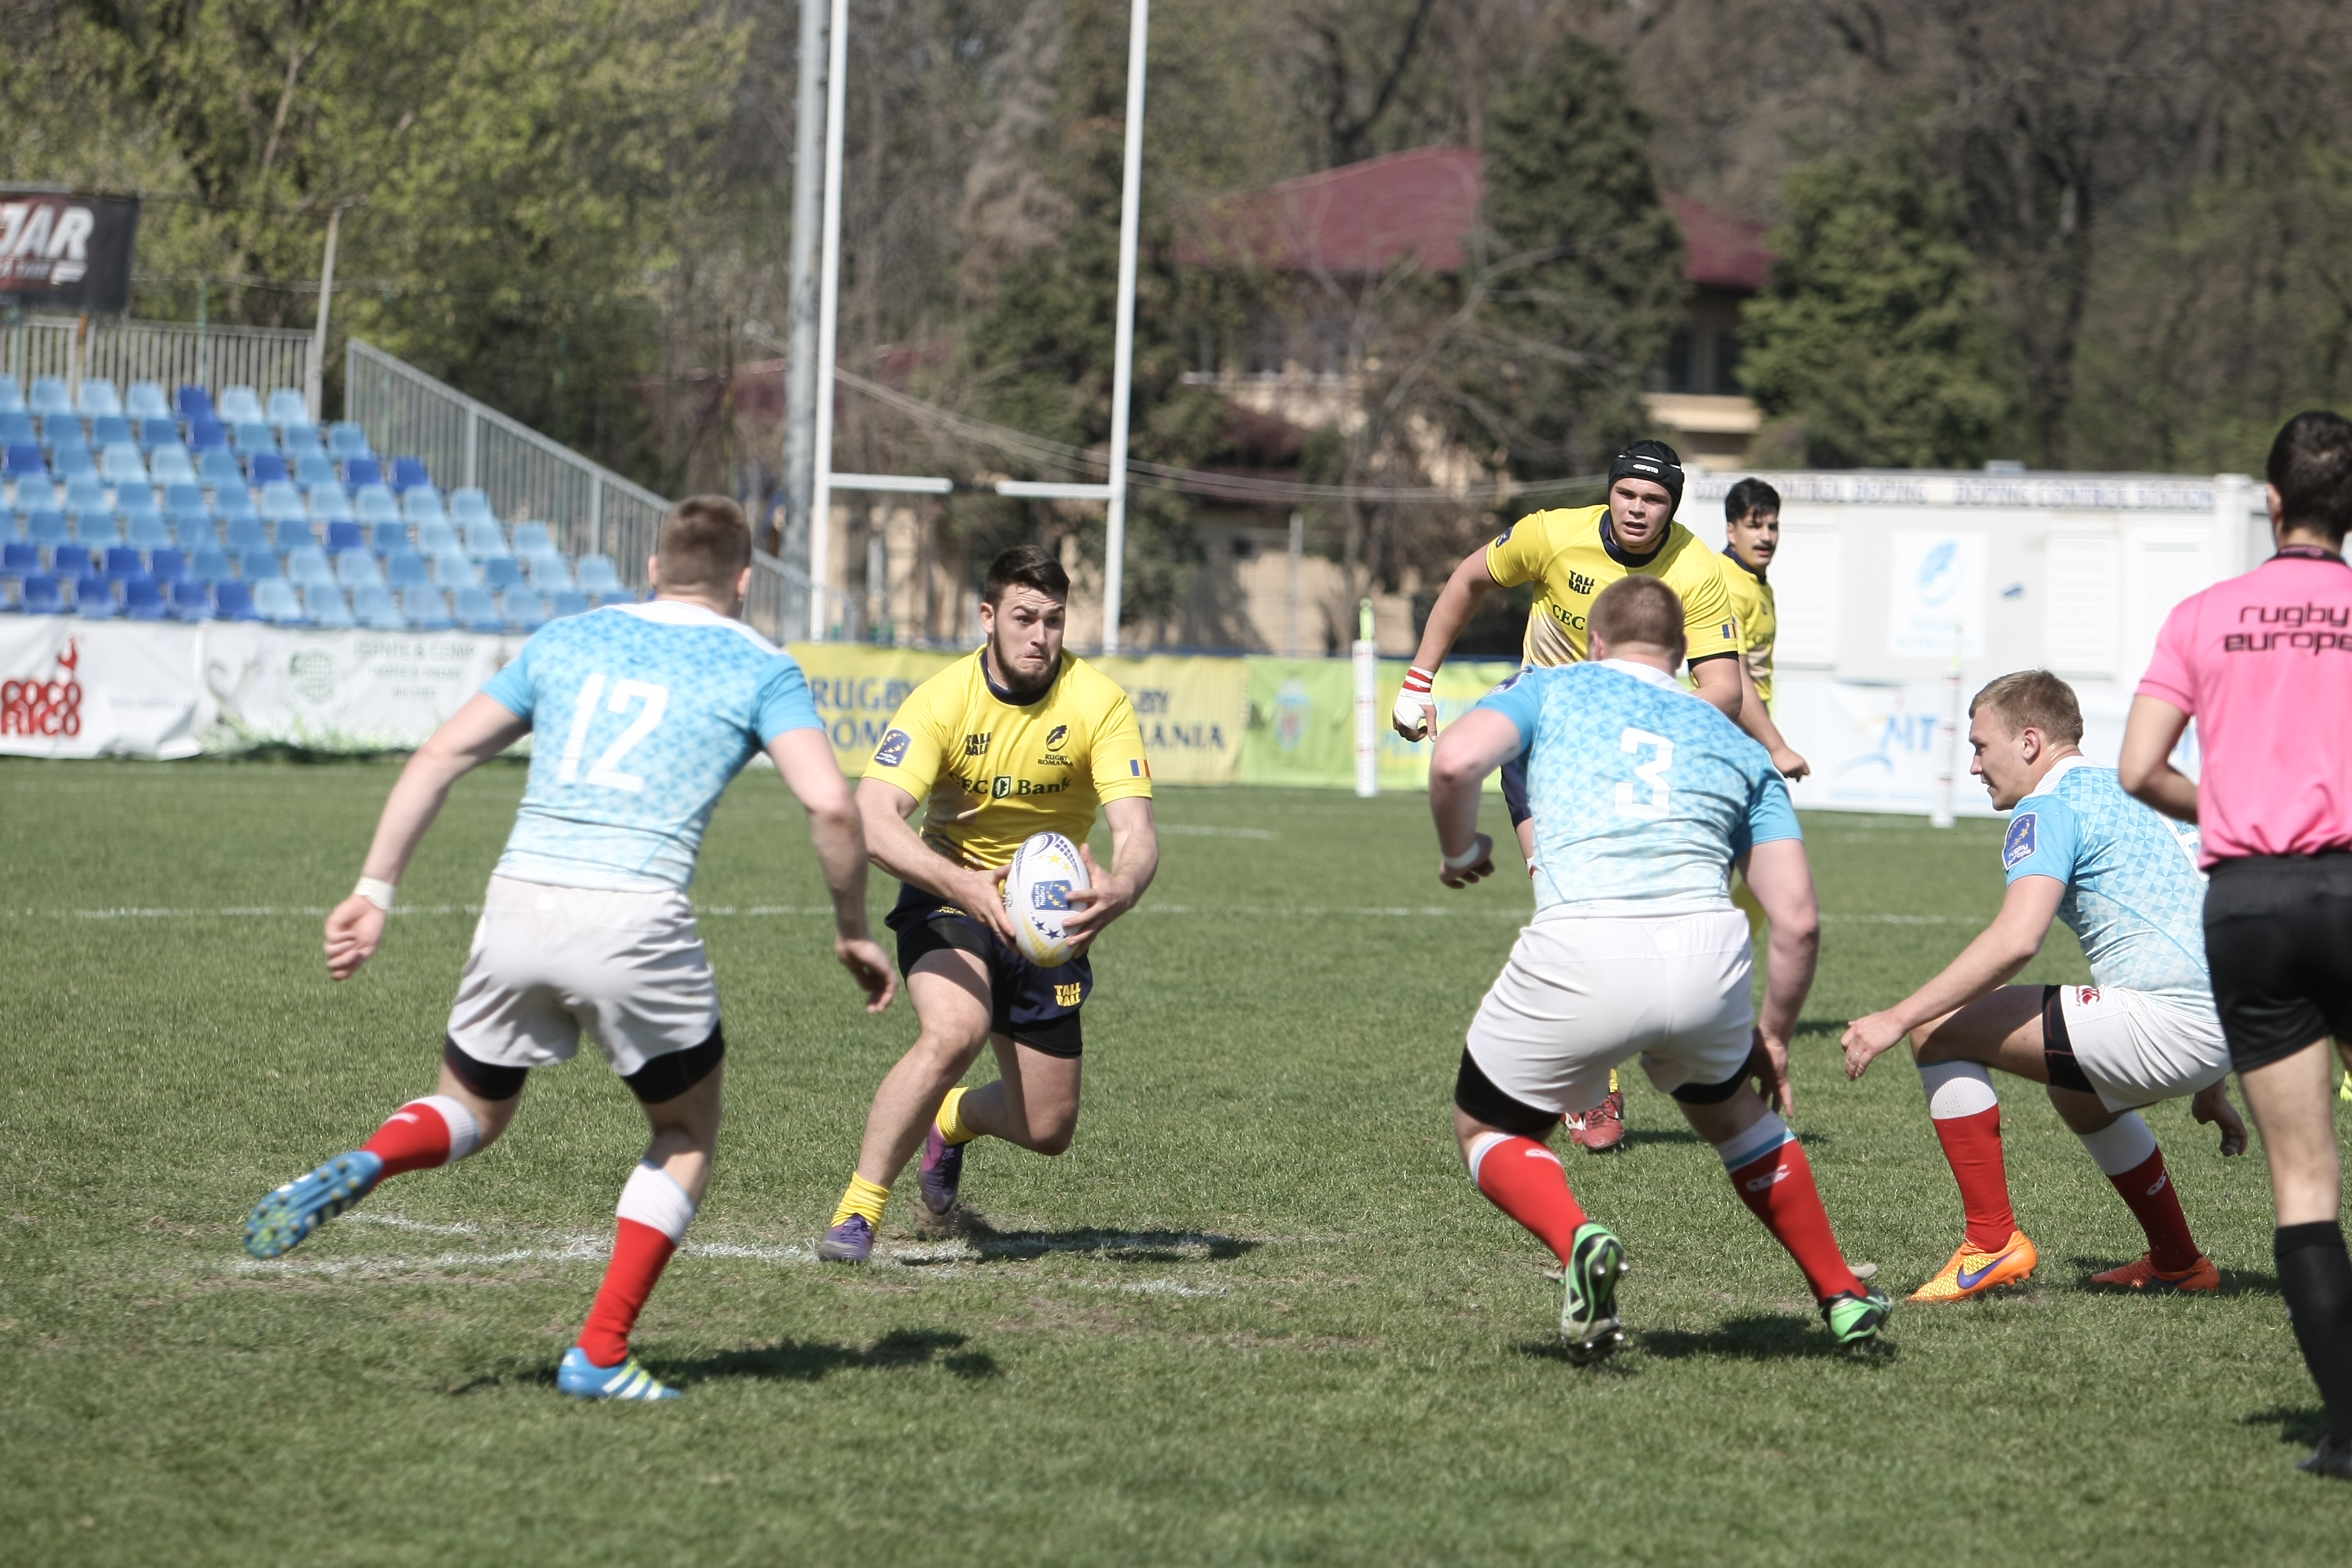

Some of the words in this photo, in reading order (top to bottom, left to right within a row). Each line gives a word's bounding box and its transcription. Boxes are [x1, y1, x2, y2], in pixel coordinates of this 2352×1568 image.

[1569, 570, 1595, 586] TALL
[1569, 579, 1592, 595] BALL
[1552, 604, 1586, 630] CEC
[2240, 602, 2350, 628] rugby
[2, 680, 82, 707] COCO
[557, 673, 668, 792] 12
[966, 732, 991, 745] TALL
[965, 743, 988, 756] BALL
[1615, 727, 1674, 819] 3
[1016, 777, 1072, 795] Bank
[1054, 982, 1081, 996] TALL
[1056, 993, 1080, 1007] BALL
